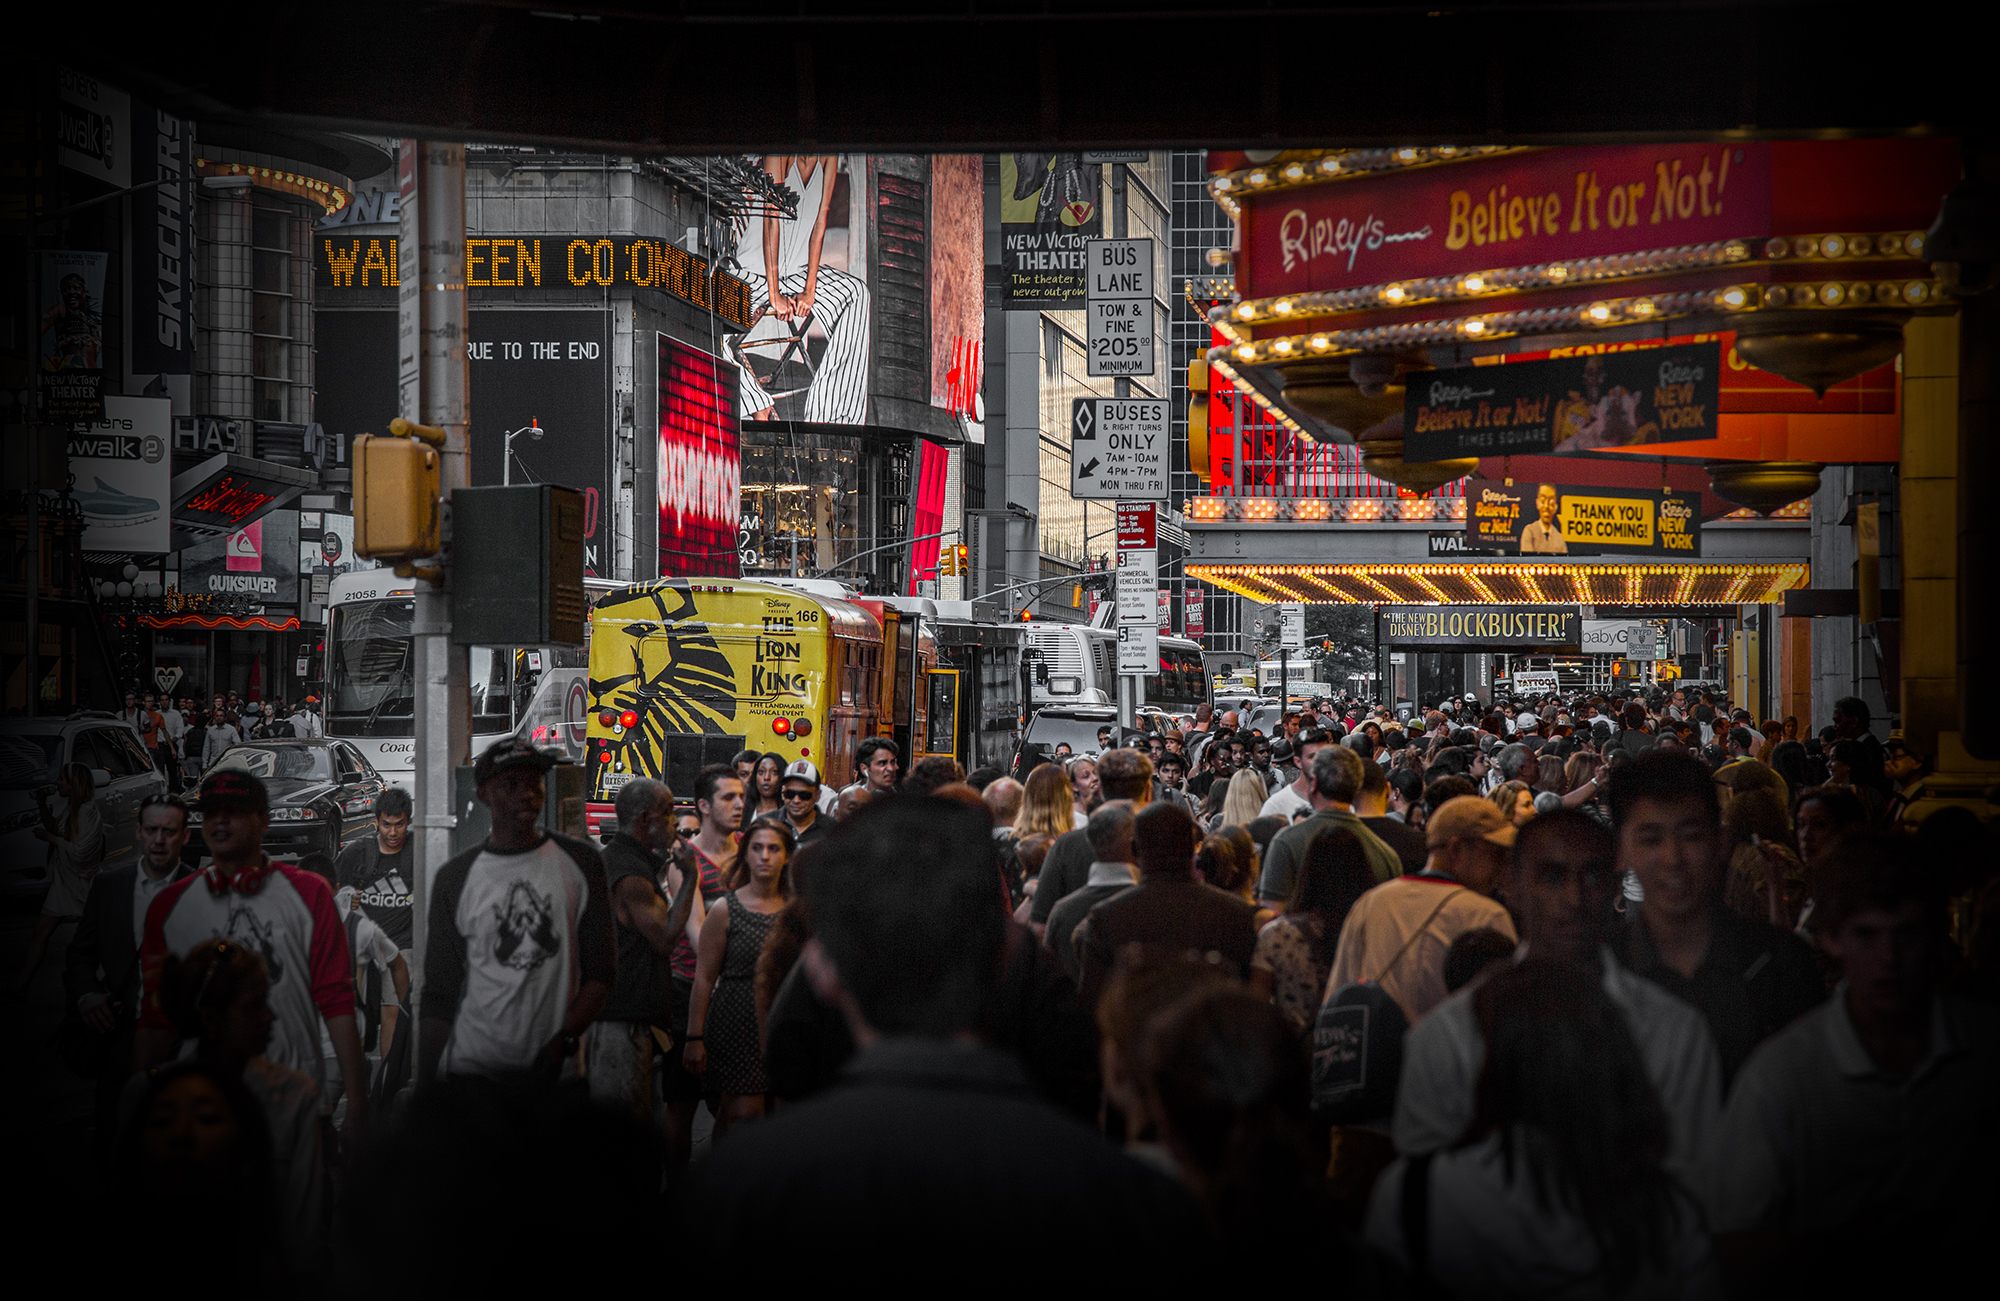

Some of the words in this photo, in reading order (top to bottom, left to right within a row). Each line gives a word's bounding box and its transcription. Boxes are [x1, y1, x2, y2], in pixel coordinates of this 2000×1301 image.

[1445, 175, 1562, 250] Believe
[1569, 170, 1601, 234] It
[1607, 181, 1647, 229] or
[1650, 147, 1731, 225] Not!
[157, 107, 181, 351] SKECHERS
[1006, 233, 1042, 250] NEW
[325, 239, 541, 287] WALEEN
[1103, 247, 1137, 266] BUS
[1011, 273, 1032, 285] The
[1034, 273, 1075, 285] theater
[1098, 273, 1142, 292] LANE
[1013, 288, 1041, 297] never
[1098, 304, 1126, 317] TOW
[1132, 304, 1142, 316] &
[1106, 321, 1135, 333] FINE
[501, 341, 523, 360] TO
[530, 341, 561, 360] THE
[568, 341, 600, 360] END
[1100, 361, 1143, 372] MINIMUM
[44, 375, 65, 386] NEW
[67, 373, 100, 387] VICTORY
[50, 385, 96, 398] THEATER
[1654, 384, 1696, 408] NEW
[1104, 405, 1162, 421] BUSES
[1659, 405, 1706, 430] YORK
[1109, 434, 1155, 449] ONLY
[1100, 480, 1120, 490] MON
[1125, 482, 1145, 490] THRU
[1148, 481, 1163, 490] FRI
[1572, 503, 1615, 520] THANK
[1618, 506, 1643, 521] YOU
[1567, 521, 1592, 536] FOR
[1596, 521, 1648, 538] COMING!
[1657, 517, 1686, 533] NEW
[1661, 533, 1694, 550] YORK
[1118, 553, 1126, 567] 3
[208, 574, 277, 594] QUIKSILVER
[345, 590, 377, 600] 21058
[762, 616, 794, 632] THE
[796, 610, 818, 622] 166
[1408, 612, 1427, 623] NEW
[1119, 627, 1127, 642] 5
[1390, 623, 1426, 636] DISNEY
[756, 636, 800, 662] LION
[751, 665, 806, 696] KING
[380, 742, 415, 753] Coac
